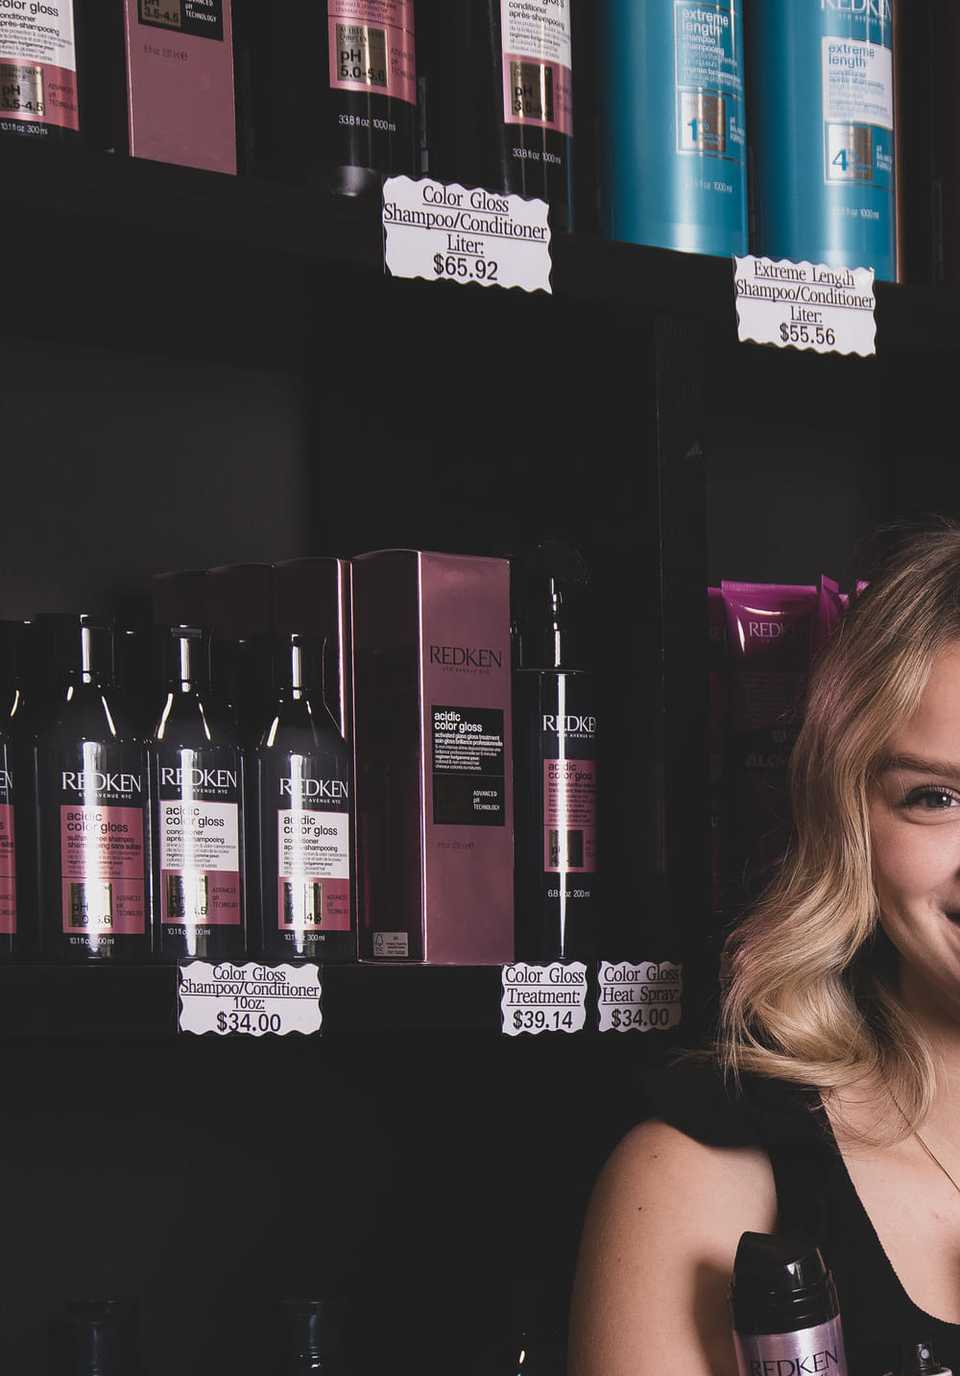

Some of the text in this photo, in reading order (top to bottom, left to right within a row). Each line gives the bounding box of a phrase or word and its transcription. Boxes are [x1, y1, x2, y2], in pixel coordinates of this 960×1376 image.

[30, 1, 60, 18] gloss
[340, 50, 362, 63] pH
[828, 43, 876, 58] extreme
[832, 148, 848, 172] 4
[422, 185, 510, 213] Color Gloss
[384, 202, 548, 241] Shampoo/Conditioner
[446, 233, 485, 256] Liter:
[433, 253, 499, 282] $65.92
[753, 260, 856, 289] Extreme Length
[736, 279, 875, 309] Shampoo/Conditioner
[790, 305, 824, 324] Liter:
[779, 322, 836, 346] $55.56
[429, 643, 503, 674] REDKEN
[433, 711, 462, 722] acidic
[434, 720, 484, 735] color gloss
[101, 825, 129, 839] gloss
[197, 817, 226, 830] gloss
[313, 825, 339, 839] gloss
[212, 965, 288, 984] Color Gloss
[505, 966, 585, 985] Color Gloss
[603, 964, 682, 984] Color Gloss
[180, 977, 321, 998] Shampoo/Conditioner
[506, 987, 582, 1005] Treatment:
[602, 986, 636, 1004] Heat
[233, 995, 266, 1011] 10oz:
[216, 1010, 282, 1033] $34.00
[512, 1009, 574, 1031] $39.14
[610, 1007, 663, 1029] $34.00
